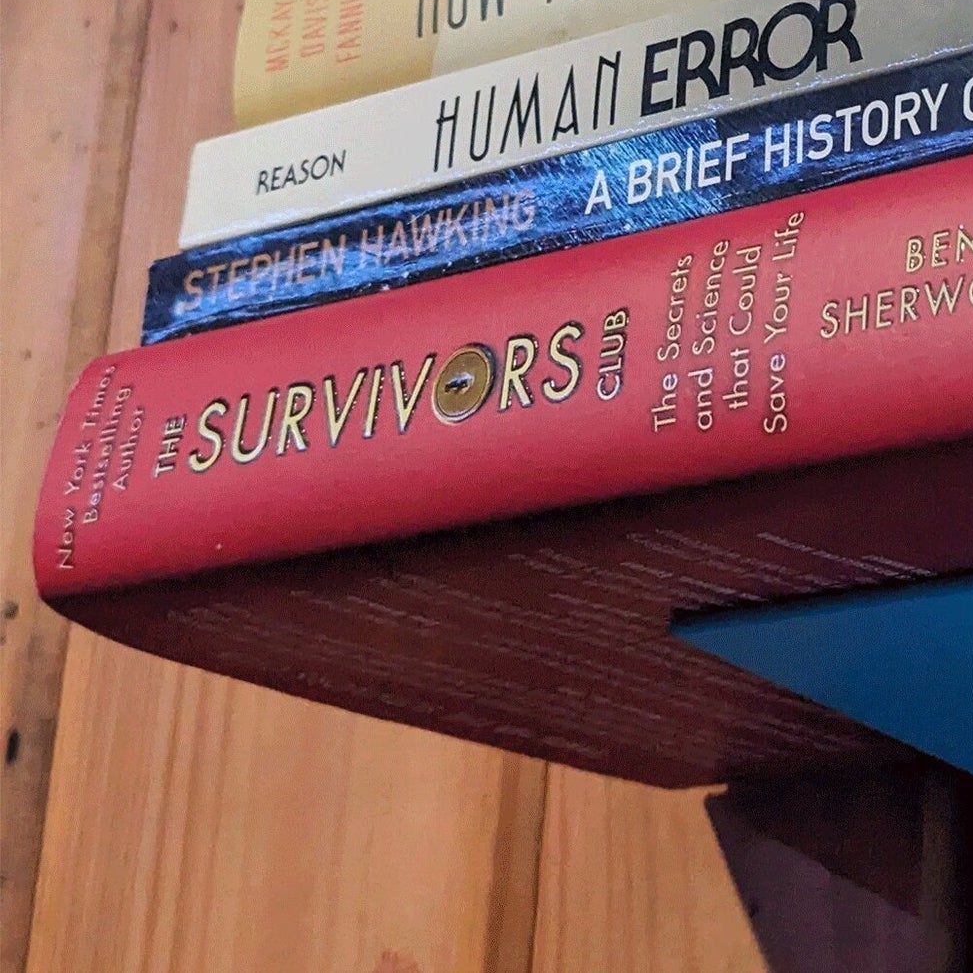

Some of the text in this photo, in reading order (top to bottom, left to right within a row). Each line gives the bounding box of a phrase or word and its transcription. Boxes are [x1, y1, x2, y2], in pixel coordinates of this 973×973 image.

[255, 149, 347, 196] REASON
[432, 48, 624, 174] HUMAN
[583, 168, 614, 216] A
[626, 132, 751, 206] BRIEF
[763, 81, 950, 174] HISTORY
[178, 187, 538, 312] STEPHEN HAWKING
[597, 308, 630, 402] CLUB
[652, 253, 694, 433] The Secrets
[687, 239, 730, 431] and Science
[722, 244, 762, 412] that Could
[763, 211, 806, 434] Save Your Life
[83, 384, 133, 525] Bestselling
[113, 406, 145, 492] Author
[153, 414, 187, 480] THE
[187, 319, 585, 473] SURVIVORS
[56, 364, 118, 569] New York Times
